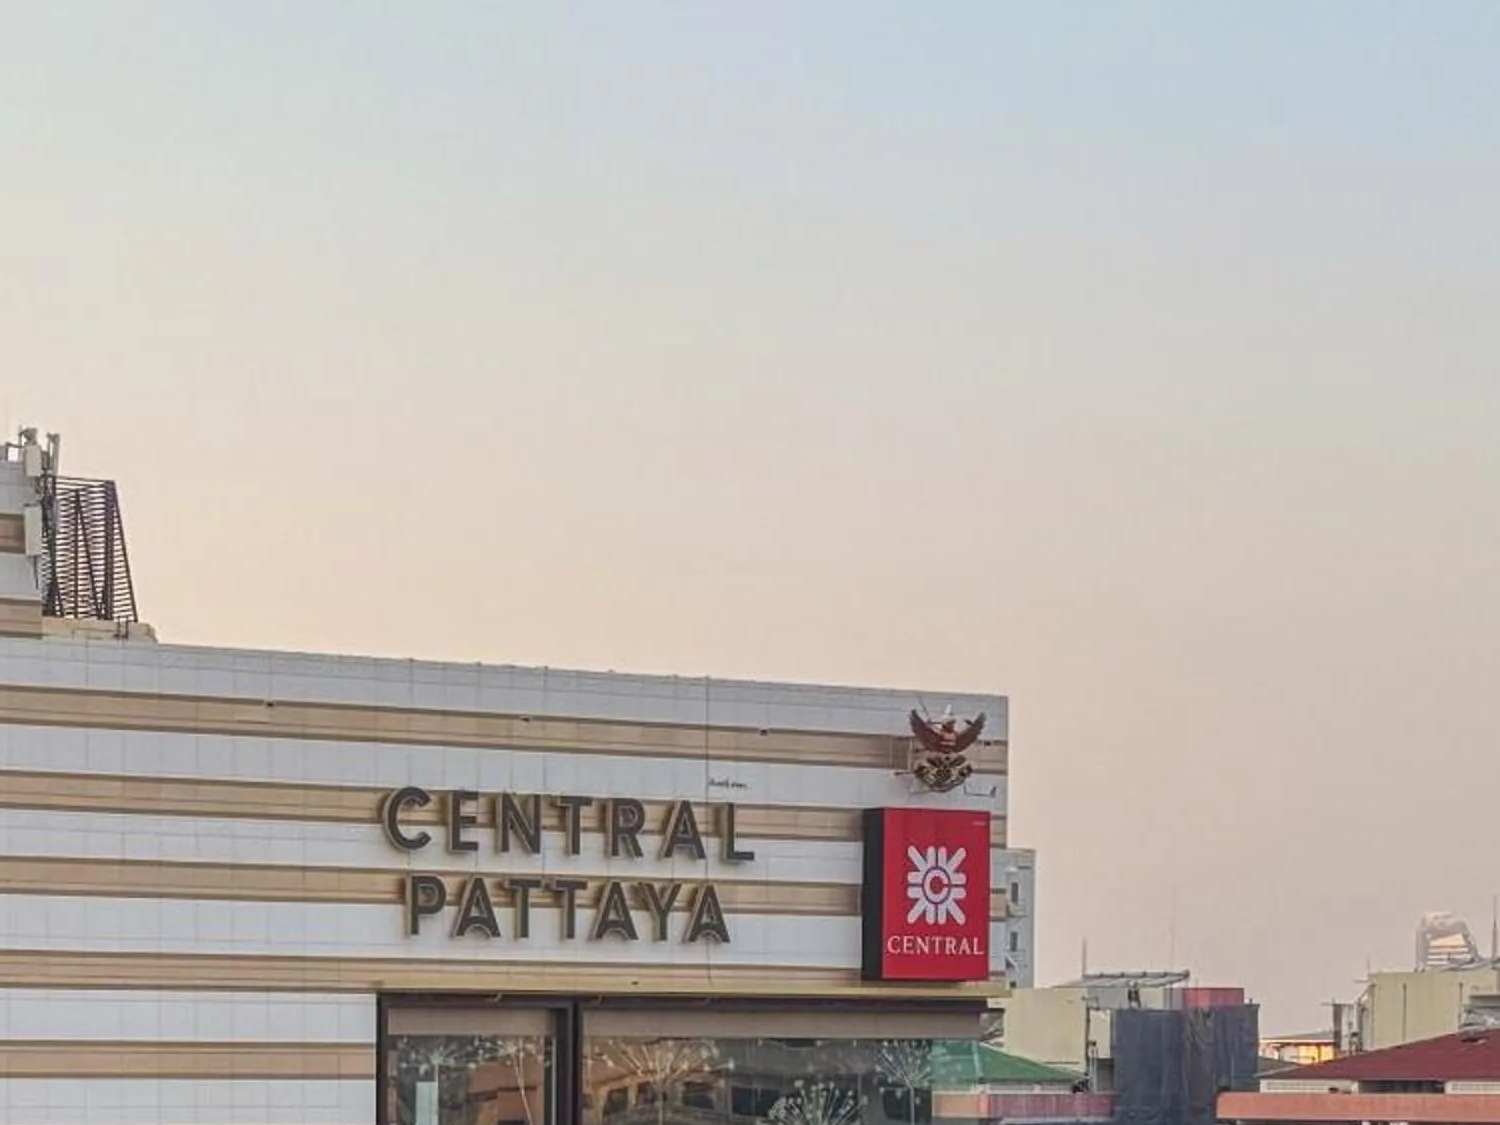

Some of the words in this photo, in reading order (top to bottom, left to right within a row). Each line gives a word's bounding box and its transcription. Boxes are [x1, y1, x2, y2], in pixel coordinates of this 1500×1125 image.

[384, 786, 755, 862] CENTRAL
[403, 874, 731, 944] PATTAYA
[887, 935, 985, 956] CENTRAL
